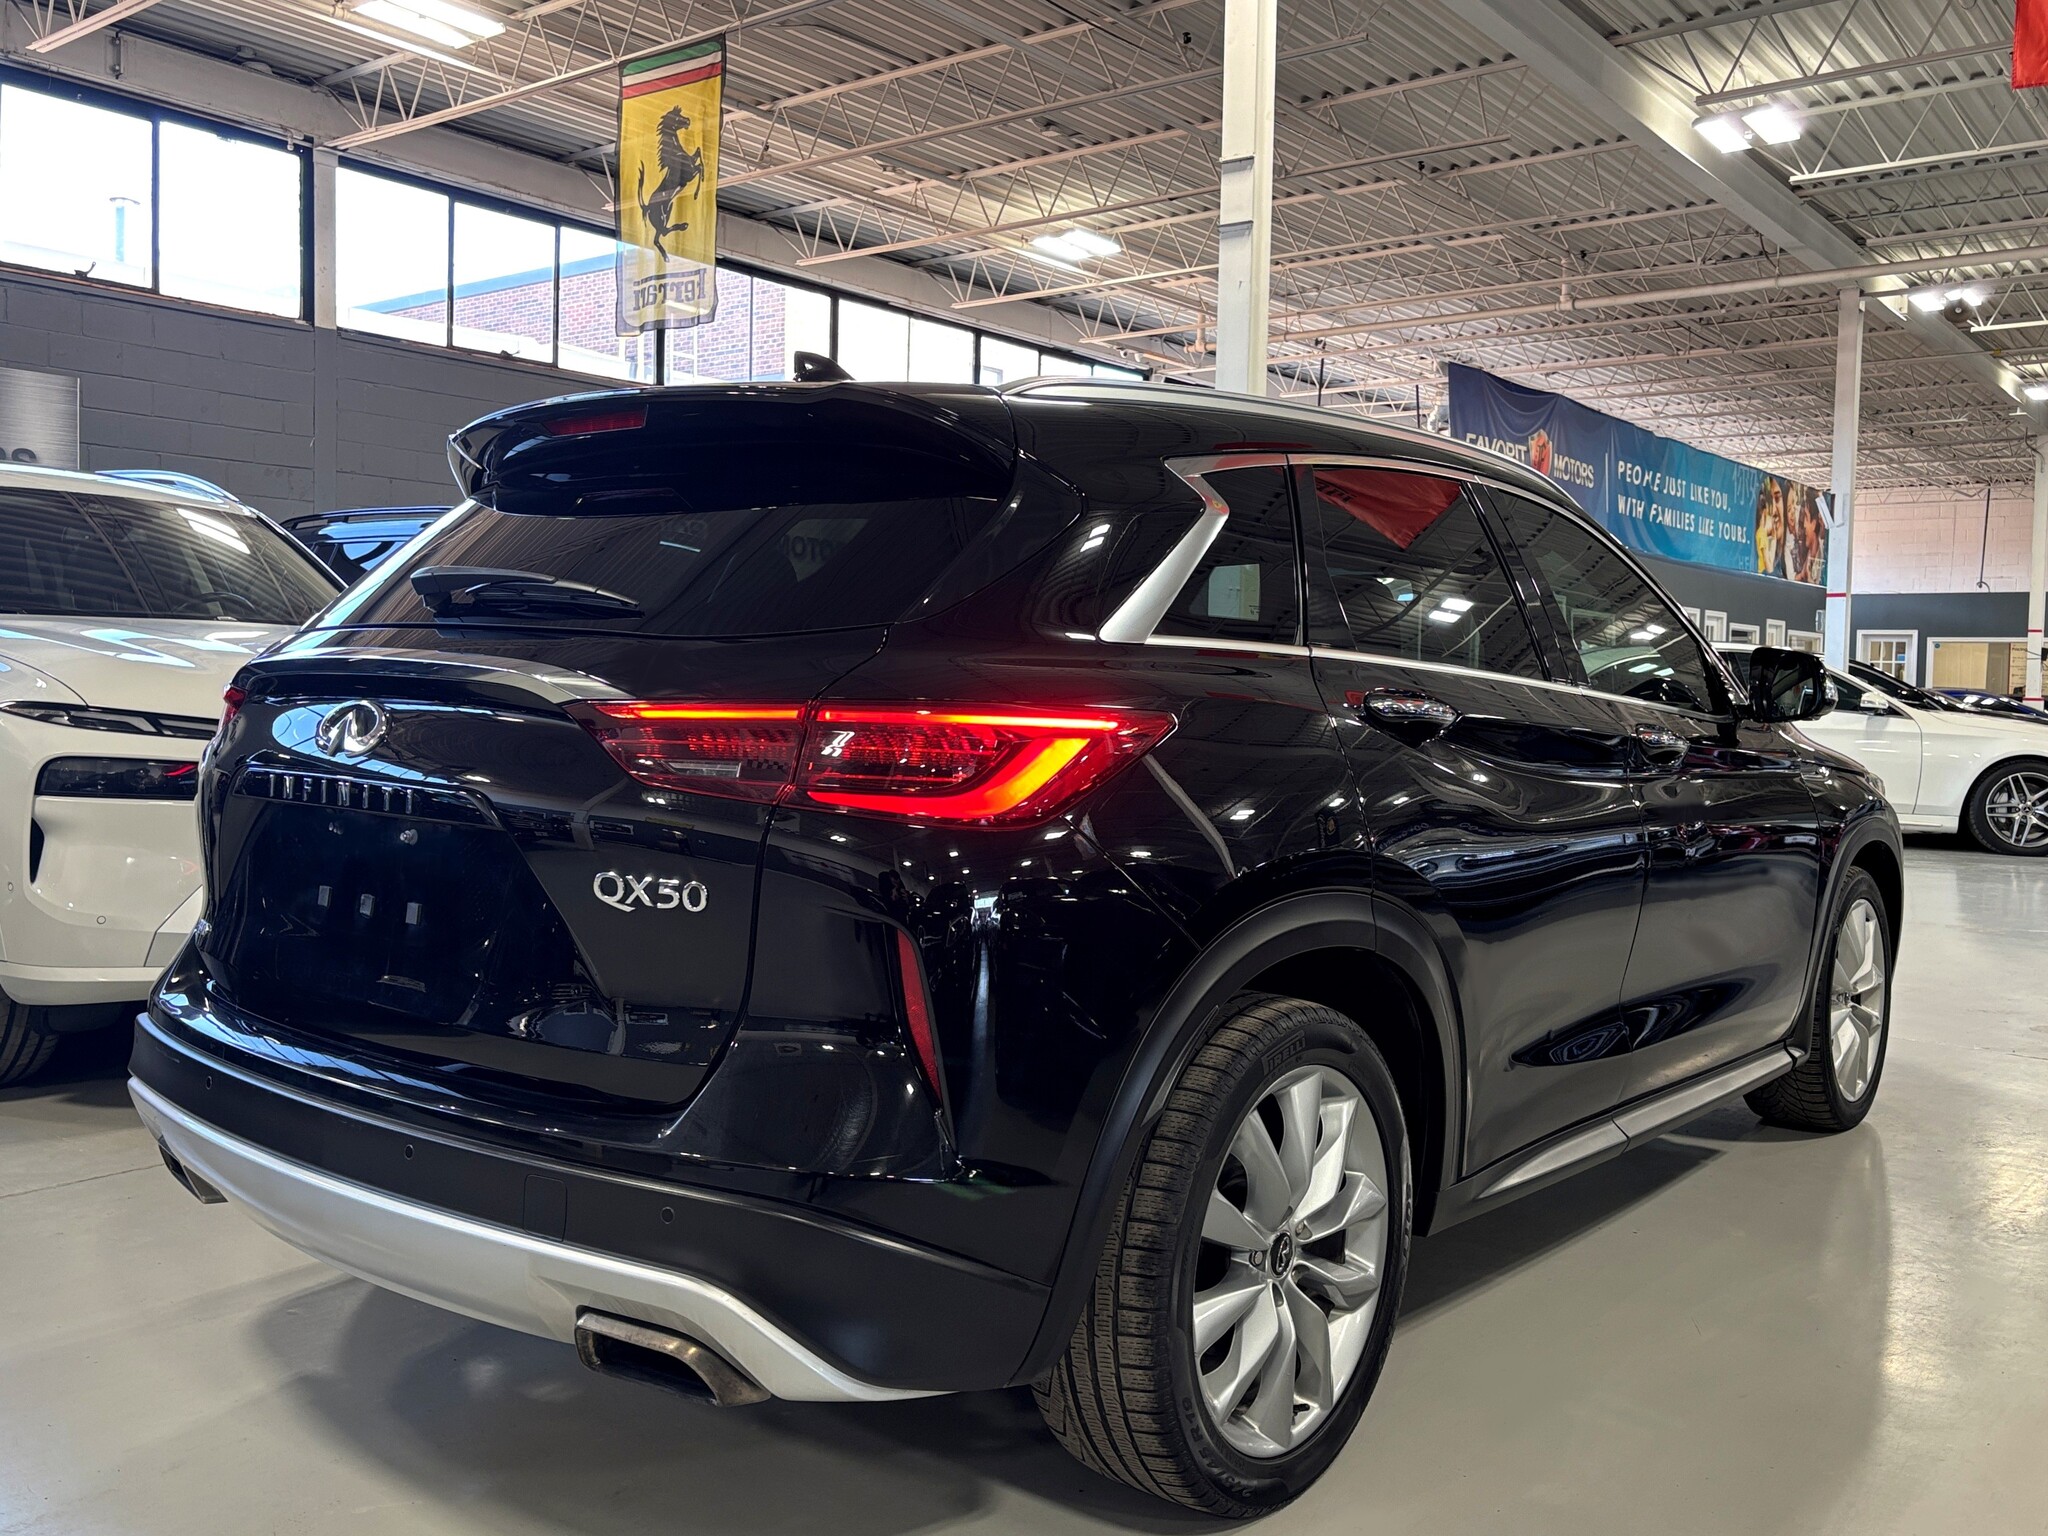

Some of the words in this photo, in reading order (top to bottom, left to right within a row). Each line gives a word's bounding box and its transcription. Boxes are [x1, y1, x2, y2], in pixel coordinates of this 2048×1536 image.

[1554, 453, 1594, 489] MOTORS
[1663, 478, 1686, 498] JUST
[1690, 483, 1708, 503] LIKE
[1711, 490, 1731, 513] YOU,
[1618, 494, 1644, 519] WITH
[1650, 503, 1695, 532] FAMILIES
[1698, 518, 1714, 537] LIKE
[1719, 523, 1750, 545] YOURS.
[270, 774, 412, 814] INFINITI
[593, 871, 707, 912] QX50
[1261, 1030, 1305, 1076] PIRELLI
